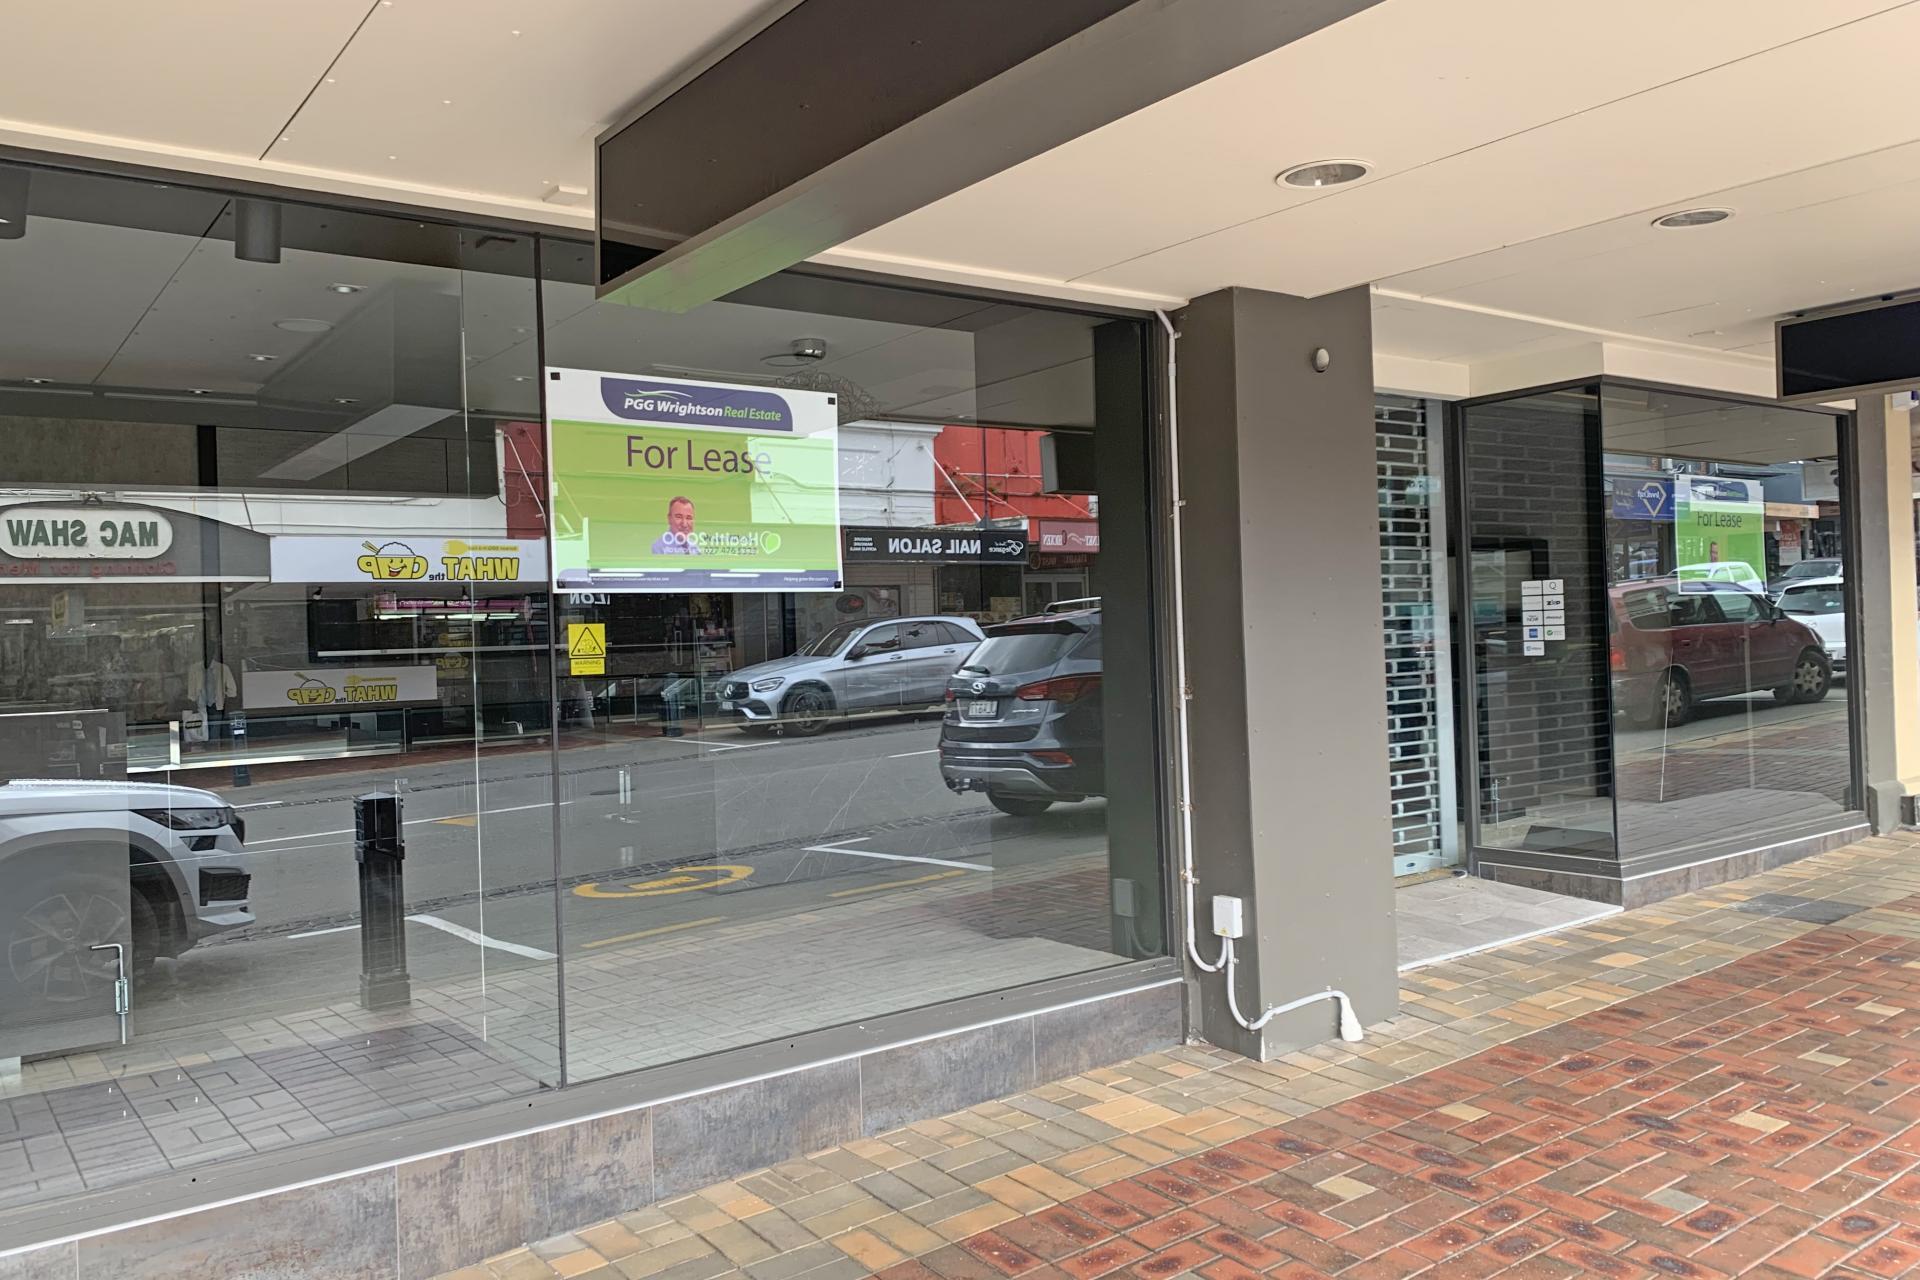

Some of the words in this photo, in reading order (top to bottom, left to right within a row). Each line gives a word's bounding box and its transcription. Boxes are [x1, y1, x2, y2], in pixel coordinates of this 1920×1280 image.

[624, 397, 654, 411] PGG
[656, 400, 723, 417] Wrightson
[723, 405, 748, 418] Real
[749, 408, 782, 421] Estate
[626, 435, 679, 469] For
[687, 439, 772, 475] Lease
[1697, 511, 1712, 527] For
[1715, 513, 1742, 528] Lease
